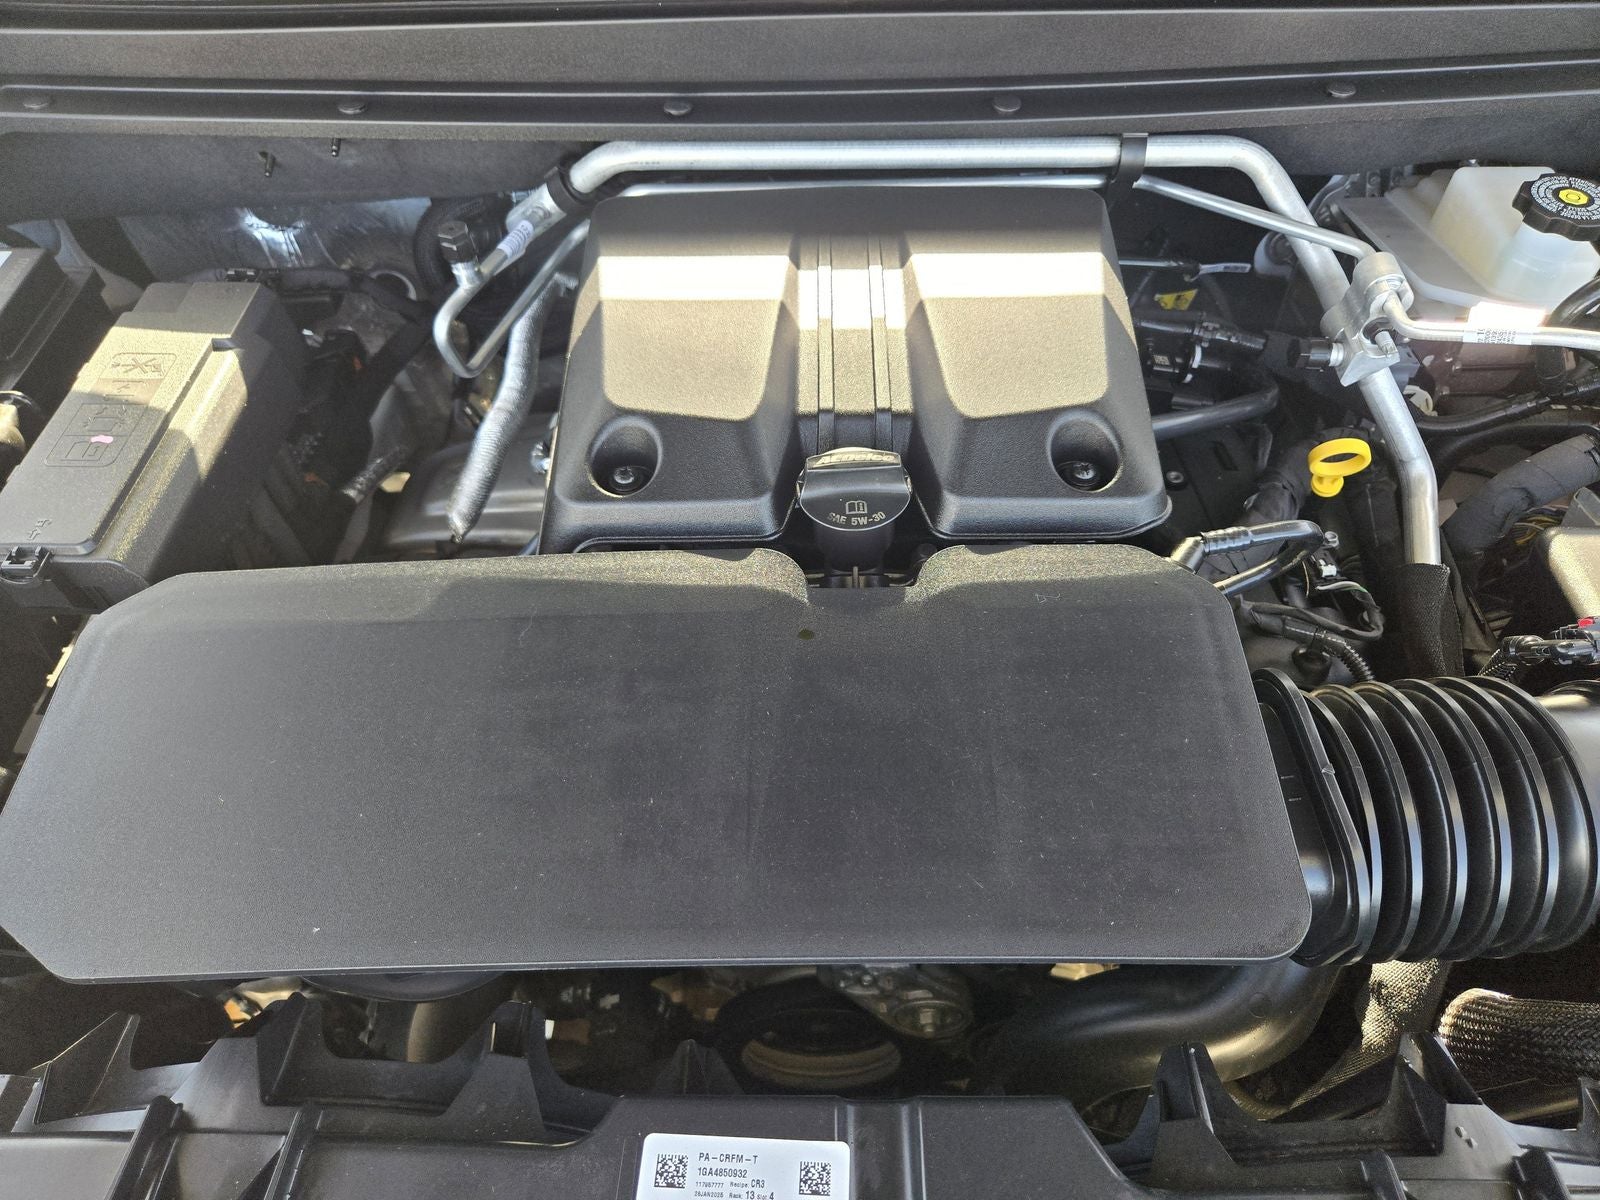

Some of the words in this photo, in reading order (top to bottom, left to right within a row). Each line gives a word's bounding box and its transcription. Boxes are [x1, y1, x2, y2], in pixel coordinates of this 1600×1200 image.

[827, 512, 847, 524] SAE
[851, 511, 886, 526] 5W-30
[697, 1167, 748, 1179] 1GA4850932
[751, 1179, 765, 1189] CR3
[745, 1190, 755, 1200] 13
[769, 1191, 775, 1200] 4
